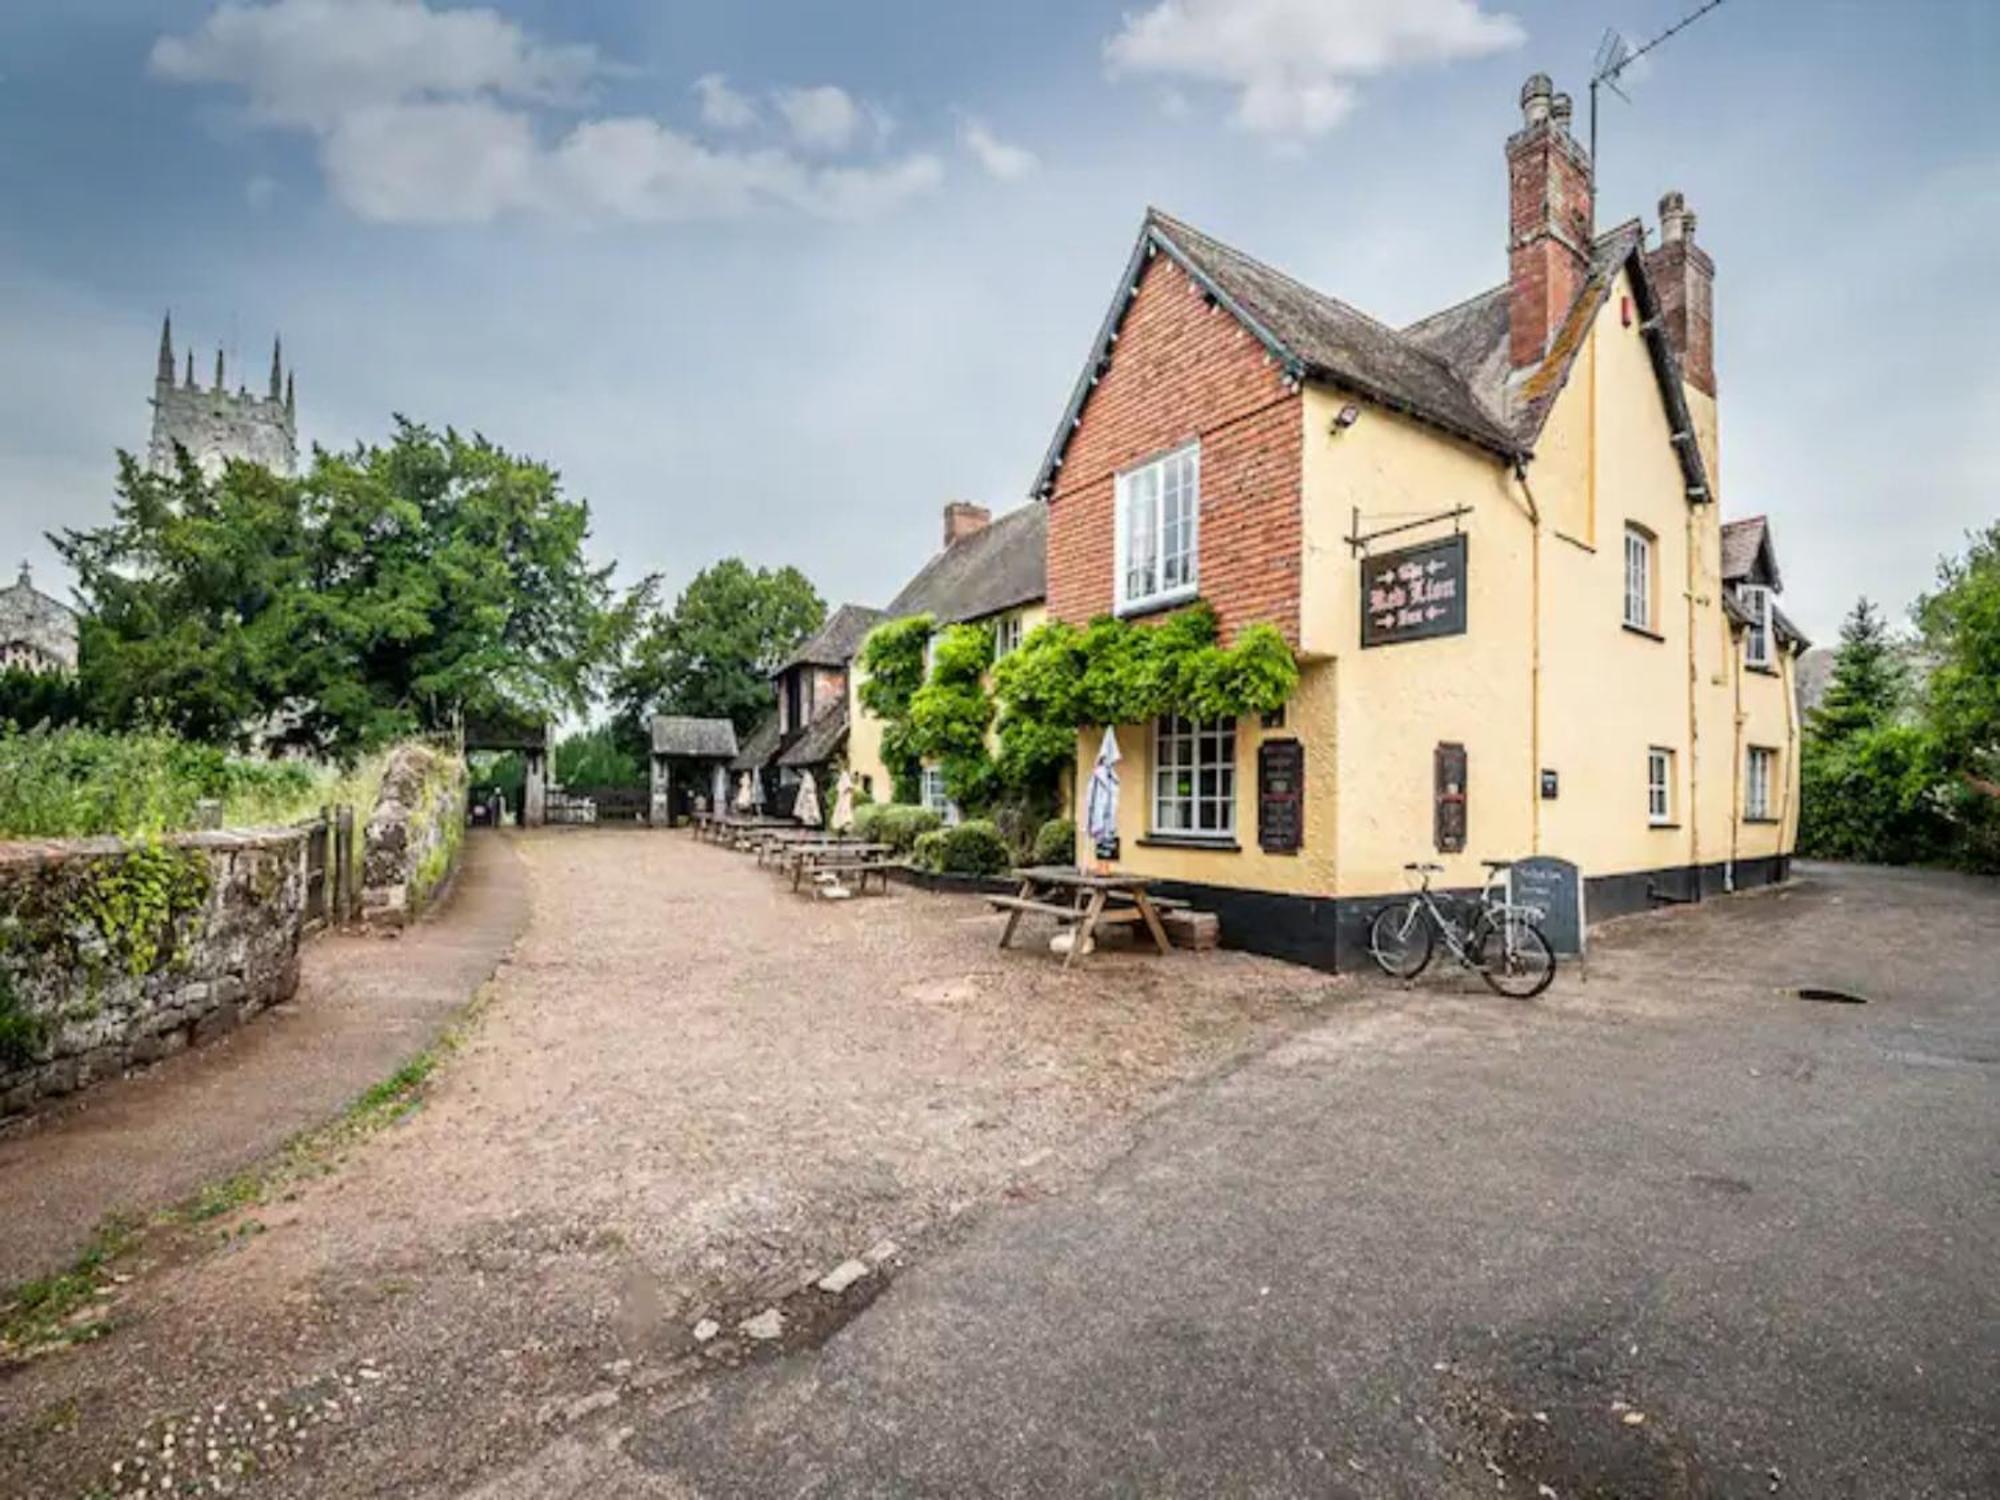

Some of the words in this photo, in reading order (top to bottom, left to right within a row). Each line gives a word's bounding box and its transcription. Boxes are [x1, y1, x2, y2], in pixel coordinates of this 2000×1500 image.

[1397, 562, 1423, 580] The
[1369, 586, 1406, 613] Red
[1408, 578, 1456, 605] Lion
[1397, 609, 1423, 627] Inn
